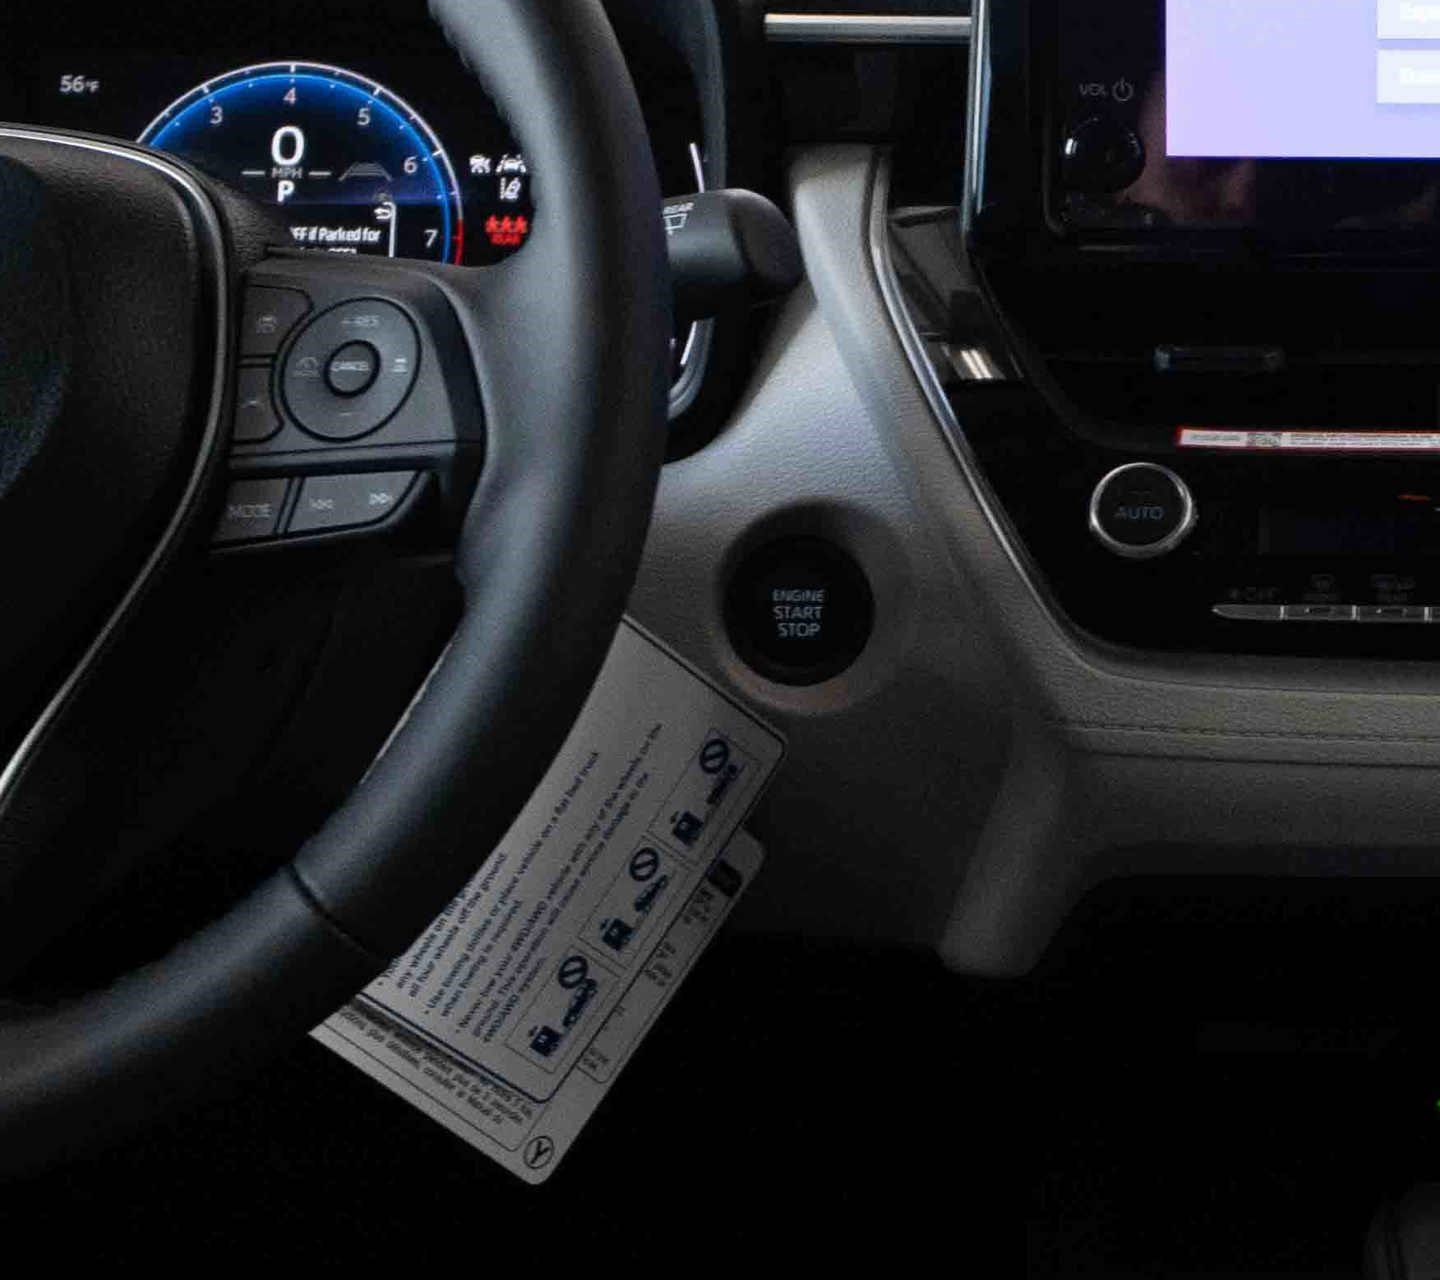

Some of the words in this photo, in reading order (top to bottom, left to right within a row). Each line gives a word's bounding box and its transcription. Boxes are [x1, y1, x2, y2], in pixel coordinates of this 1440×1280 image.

[283, 88, 296, 105] 4
[211, 106, 223, 124] 3
[357, 107, 371, 125] 5
[271, 126, 305, 166] 0
[404, 156, 418, 174] 6
[271, 168, 303, 180] MPH
[277, 180, 295, 203] P
[319, 227, 363, 241] Parked
[363, 227, 382, 241] for
[424, 229, 438, 248] 7
[1114, 506, 1166, 521] AUTO
[772, 589, 824, 602] ENGINE
[773, 606, 823, 621] START
[778, 622, 821, 638] STOP
